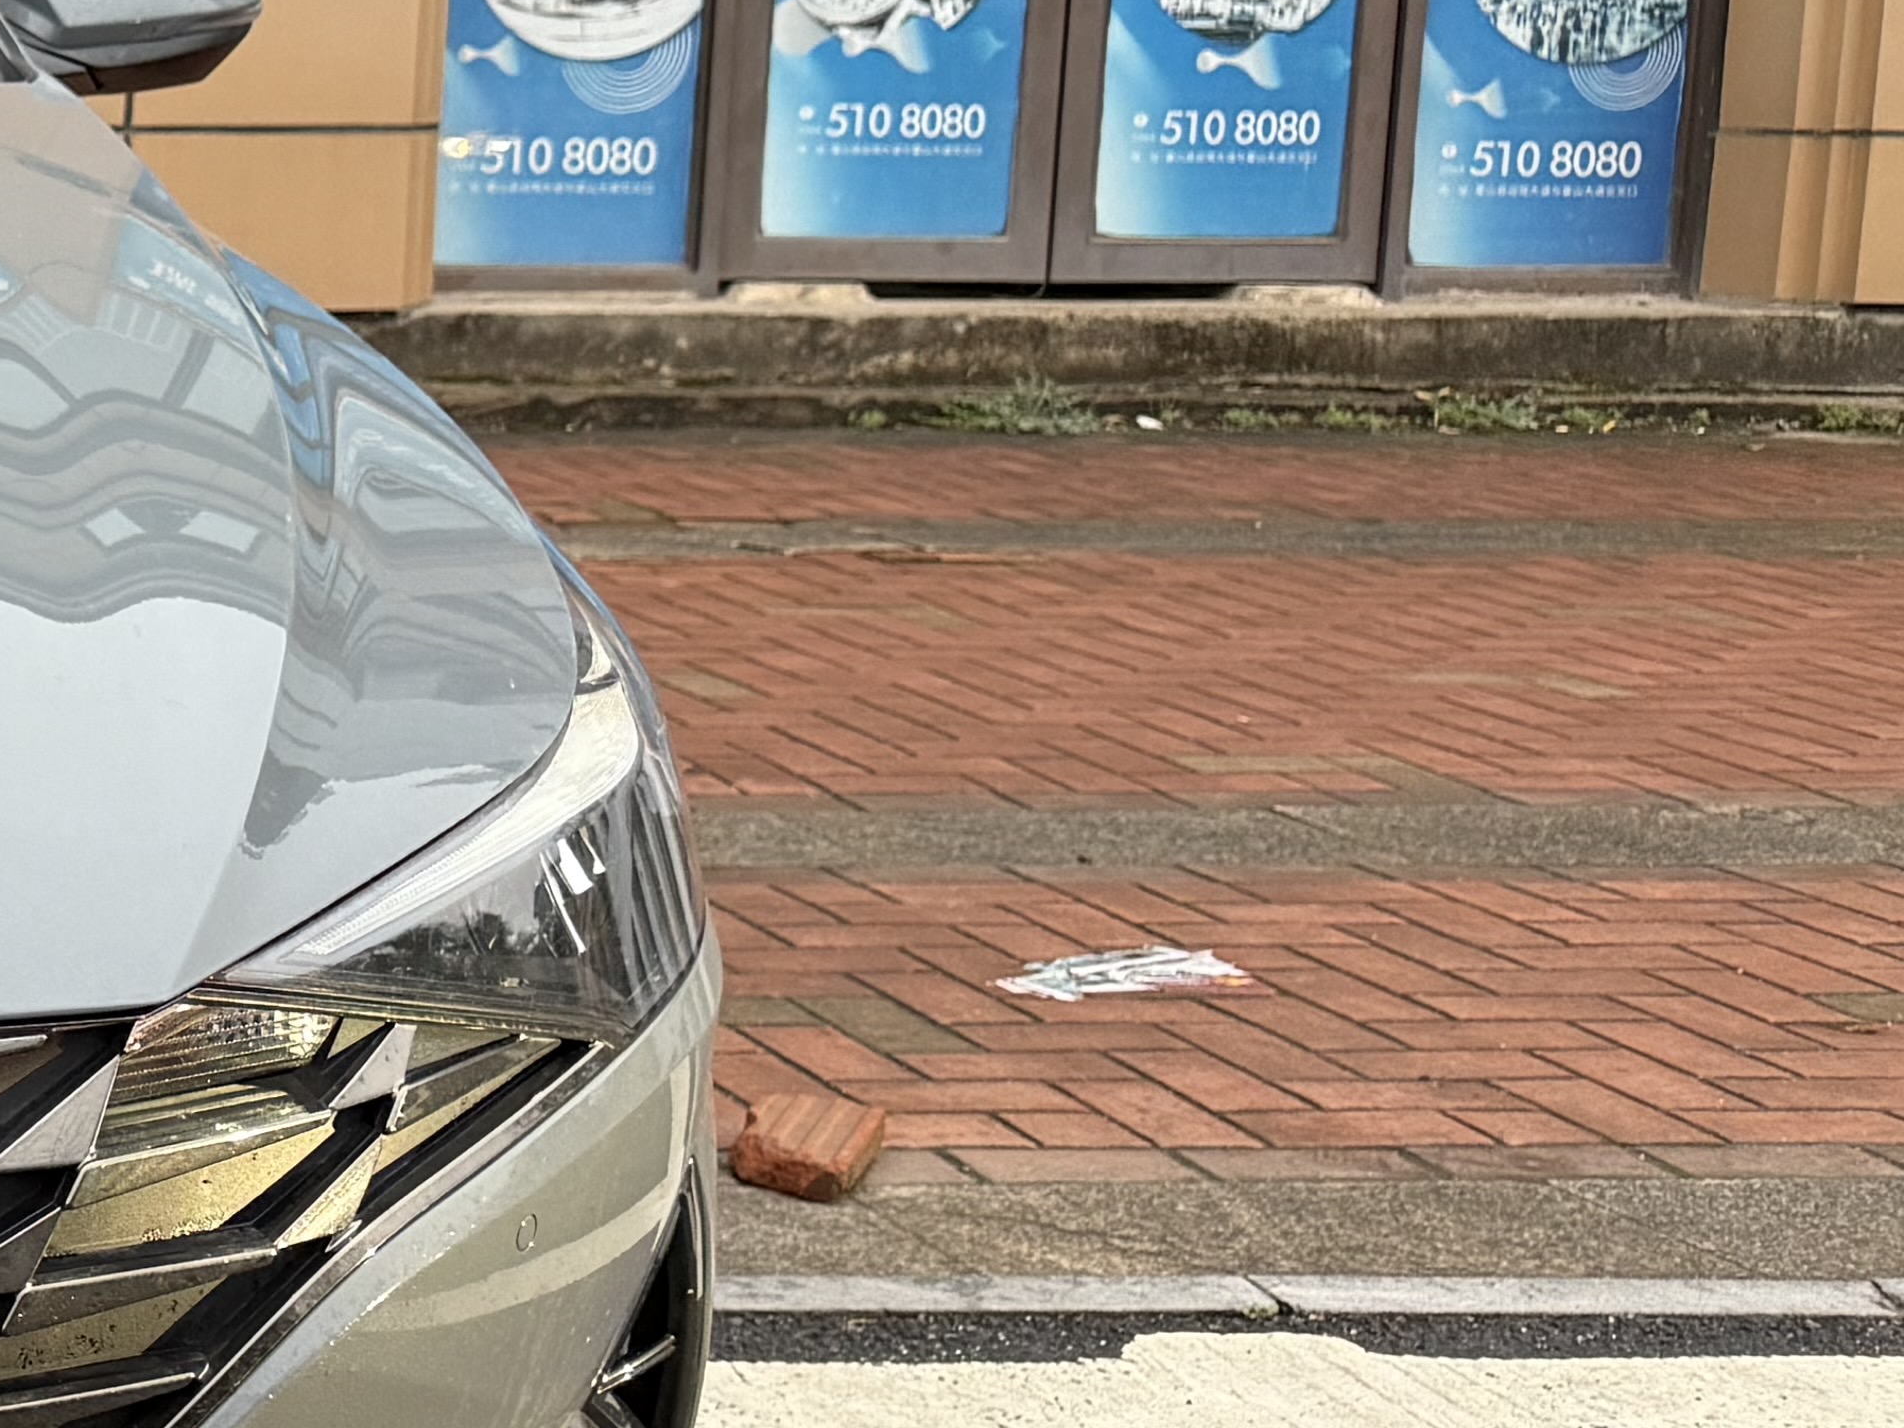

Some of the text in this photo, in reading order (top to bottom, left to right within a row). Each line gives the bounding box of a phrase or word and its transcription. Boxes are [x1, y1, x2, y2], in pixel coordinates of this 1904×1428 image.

[824, 101, 986, 140] 510 8080
[1159, 109, 1321, 147] 510 8080
[478, 136, 657, 177] 510 8080
[1469, 139, 1643, 179] 510 8080
